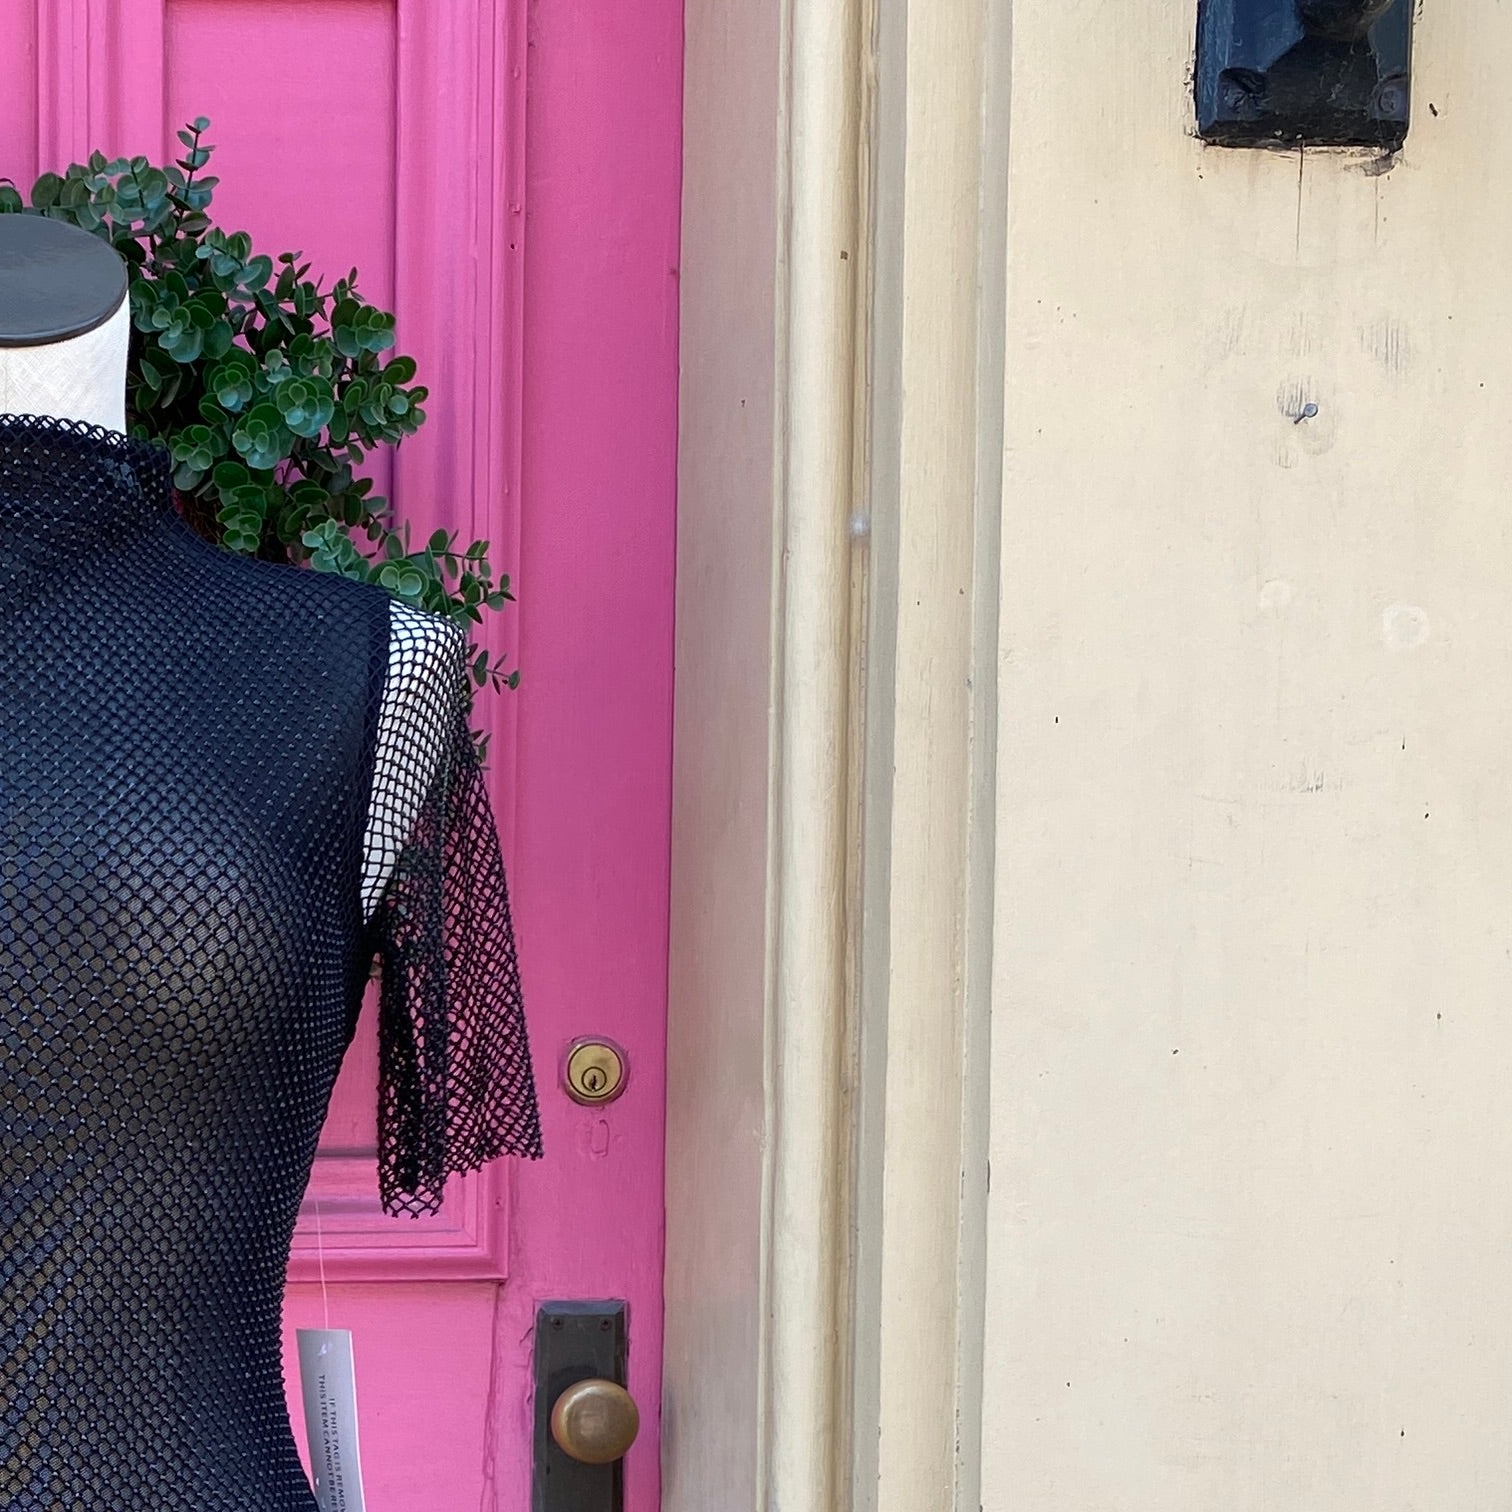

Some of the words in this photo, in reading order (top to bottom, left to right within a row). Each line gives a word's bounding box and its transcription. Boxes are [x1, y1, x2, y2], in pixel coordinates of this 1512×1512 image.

[329, 1398, 336, 1408] IF
[320, 1402, 329, 1428] ITEM
[330, 1411, 338, 1435] THIS
[323, 1430, 334, 1478] CANNOT
[332, 1439, 340, 1459] TAG
[335, 1462, 341, 1472] IS
[328, 1480, 336, 1493] BE
